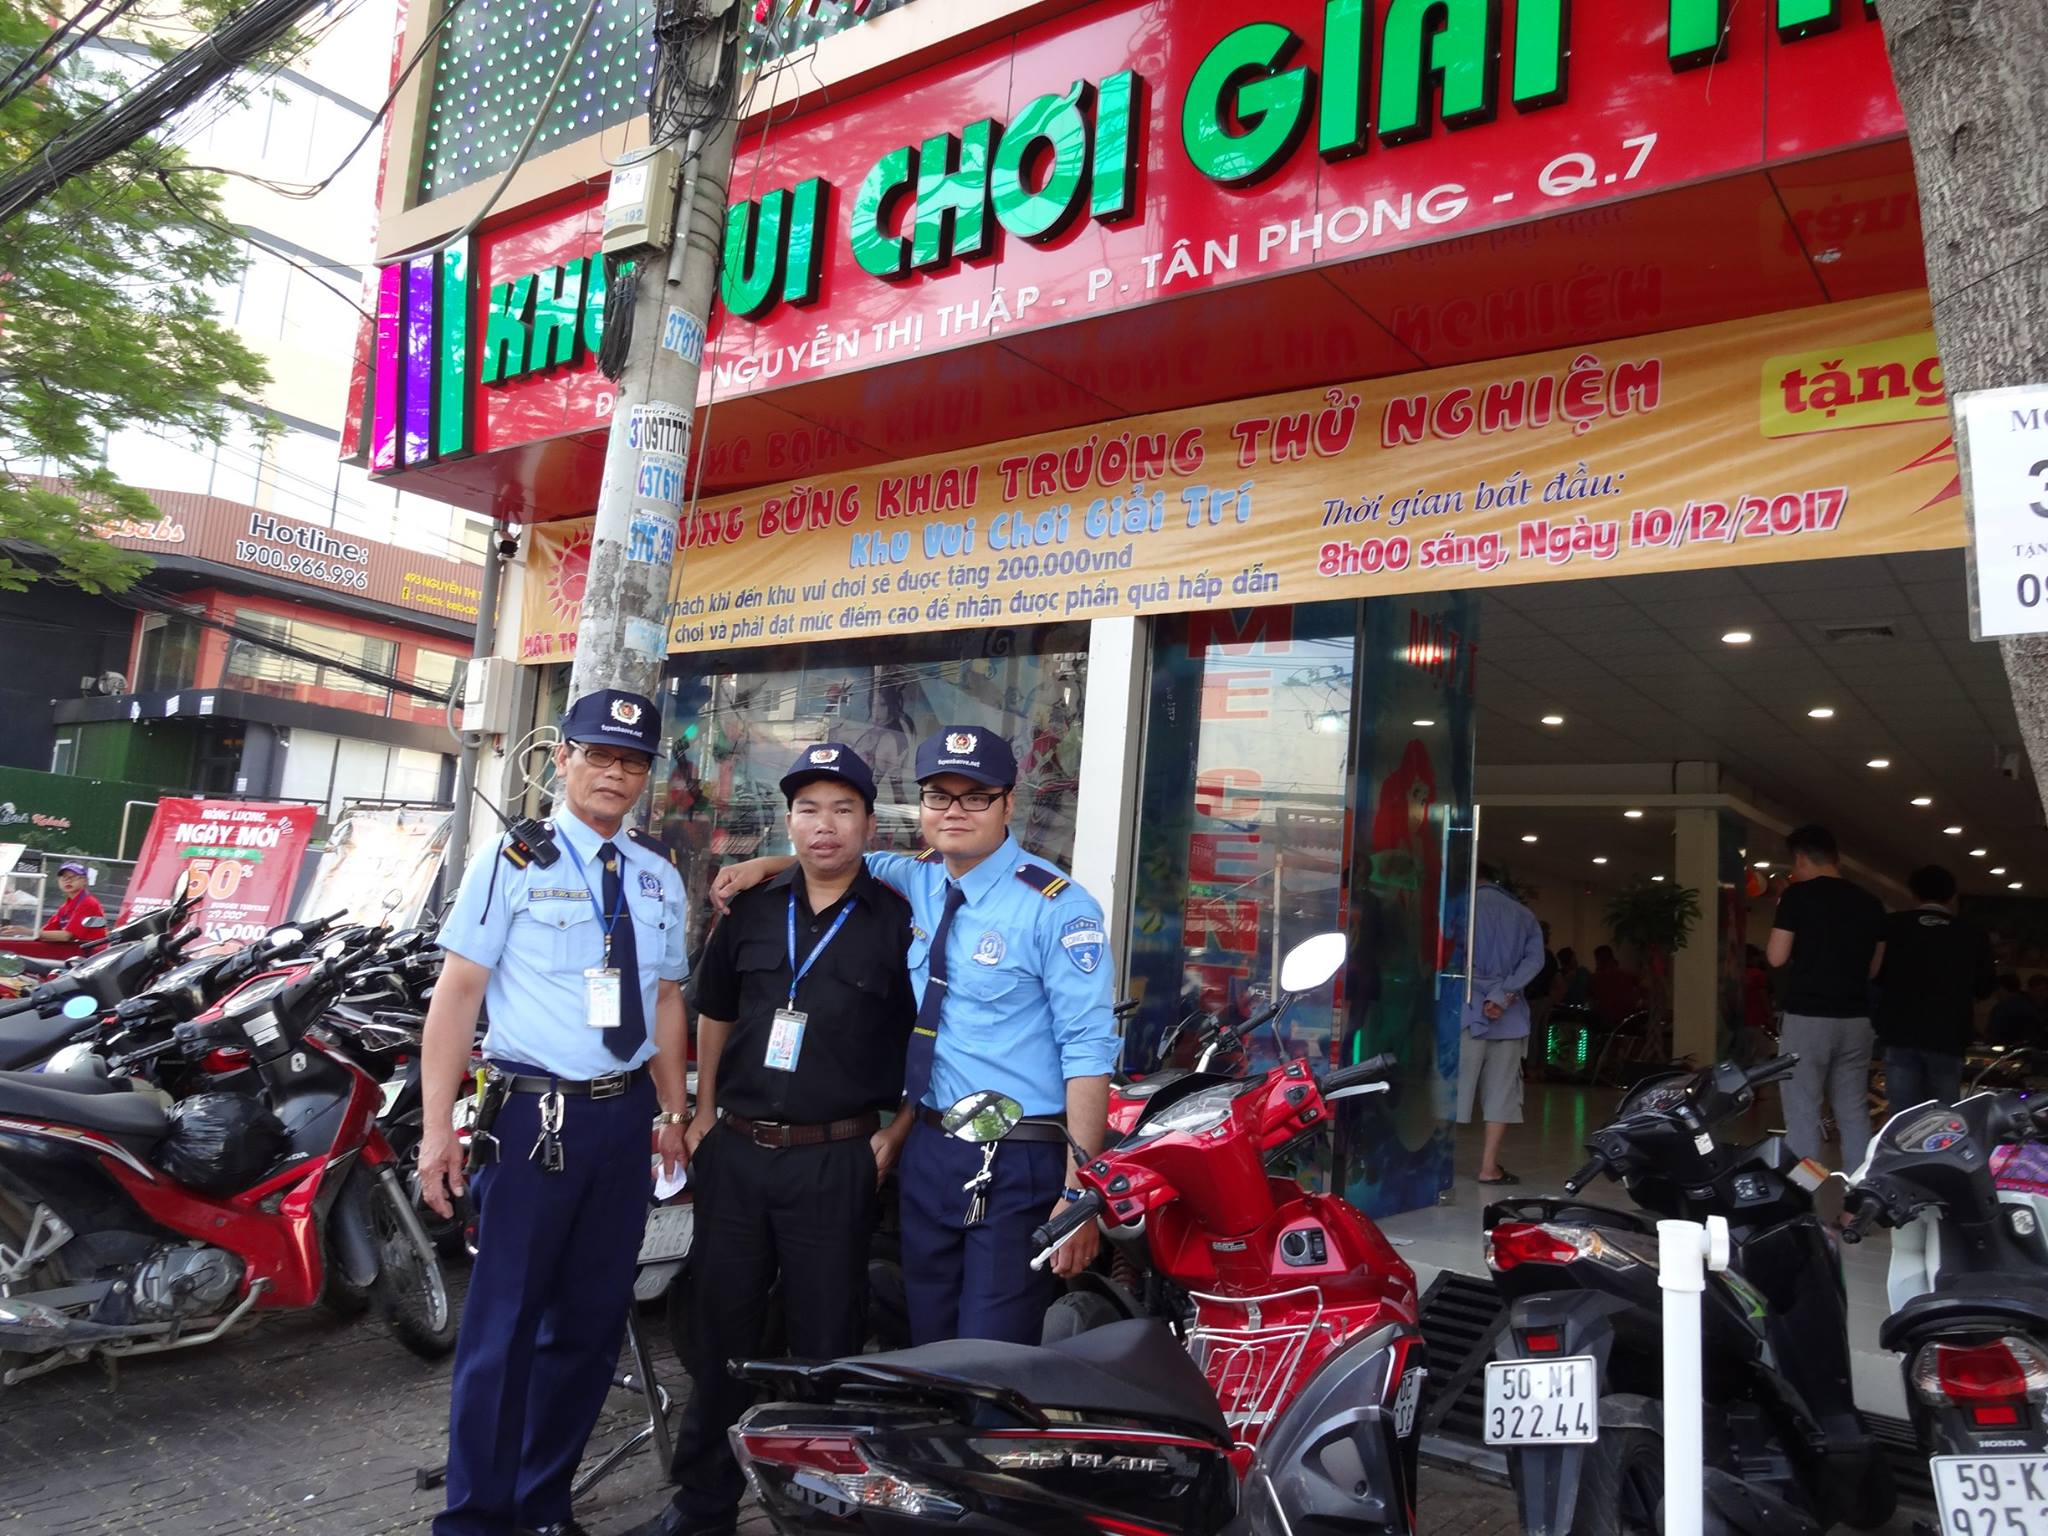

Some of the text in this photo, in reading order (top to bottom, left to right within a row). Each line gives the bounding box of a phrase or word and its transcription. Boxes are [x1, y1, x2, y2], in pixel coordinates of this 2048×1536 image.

[720, 178, 826, 318] UI
[850, 70, 1142, 278] CHƠI
[713, 323, 860, 388] NGUYỄN
[872, 316, 924, 353] THỊ
[936, 285, 1041, 334] THẬP
[1140, 237, 1239, 292] TÂN
[1258, 183, 1469, 266] PHONG
[1537, 134, 1661, 202] Q.7
[1778, 356, 1948, 419] tặng
[757, 485, 861, 539] BỪNG
[875, 464, 981, 520] KHAI
[997, 427, 1207, 501] TRƯƠNG
[1230, 388, 1362, 468] THỬ
[1380, 353, 1665, 450] NGHIỆM
[849, 480, 1255, 569] Khu Vui Chơi Giải Trí
[1320, 460, 1626, 528] Thời gian bắt đầu:
[235, 538, 369, 592] 1900.966.996
[249, 512, 370, 565] Hotline:
[1316, 485, 1849, 578] 8h00 sáng, Ngày 10/12/2017
[446, 600, 479, 616] kebab
[708, 591, 732, 613] khi
[734, 586, 763, 608] đến
[766, 584, 796, 606] khu
[802, 579, 827, 602] vui
[831, 574, 867, 599] chơi
[871, 572, 891, 596] sẽ
[896, 568, 941, 595] được
[948, 563, 990, 590] tặng
[995, 543, 1134, 582] 200.000vnđ
[709, 620, 728, 640] và
[730, 614, 764, 644] phải
[768, 612, 795, 639] đạt
[839, 602, 881, 628] điểm
[887, 604, 919, 625] cao
[926, 593, 950, 621] để
[955, 594, 1002, 623] nhận
[1009, 589, 1060, 618] được
[1064, 577, 1120, 615] phần
[1126, 575, 1171, 610] quà
[1177, 568, 1223, 604] hấp
[1231, 562, 1280, 595] dẫn
[1491, 1402, 1589, 1439] 322.44
[1978, 1439, 2027, 1448] HONDA
[1952, 1507, 2048, 1536] 925
